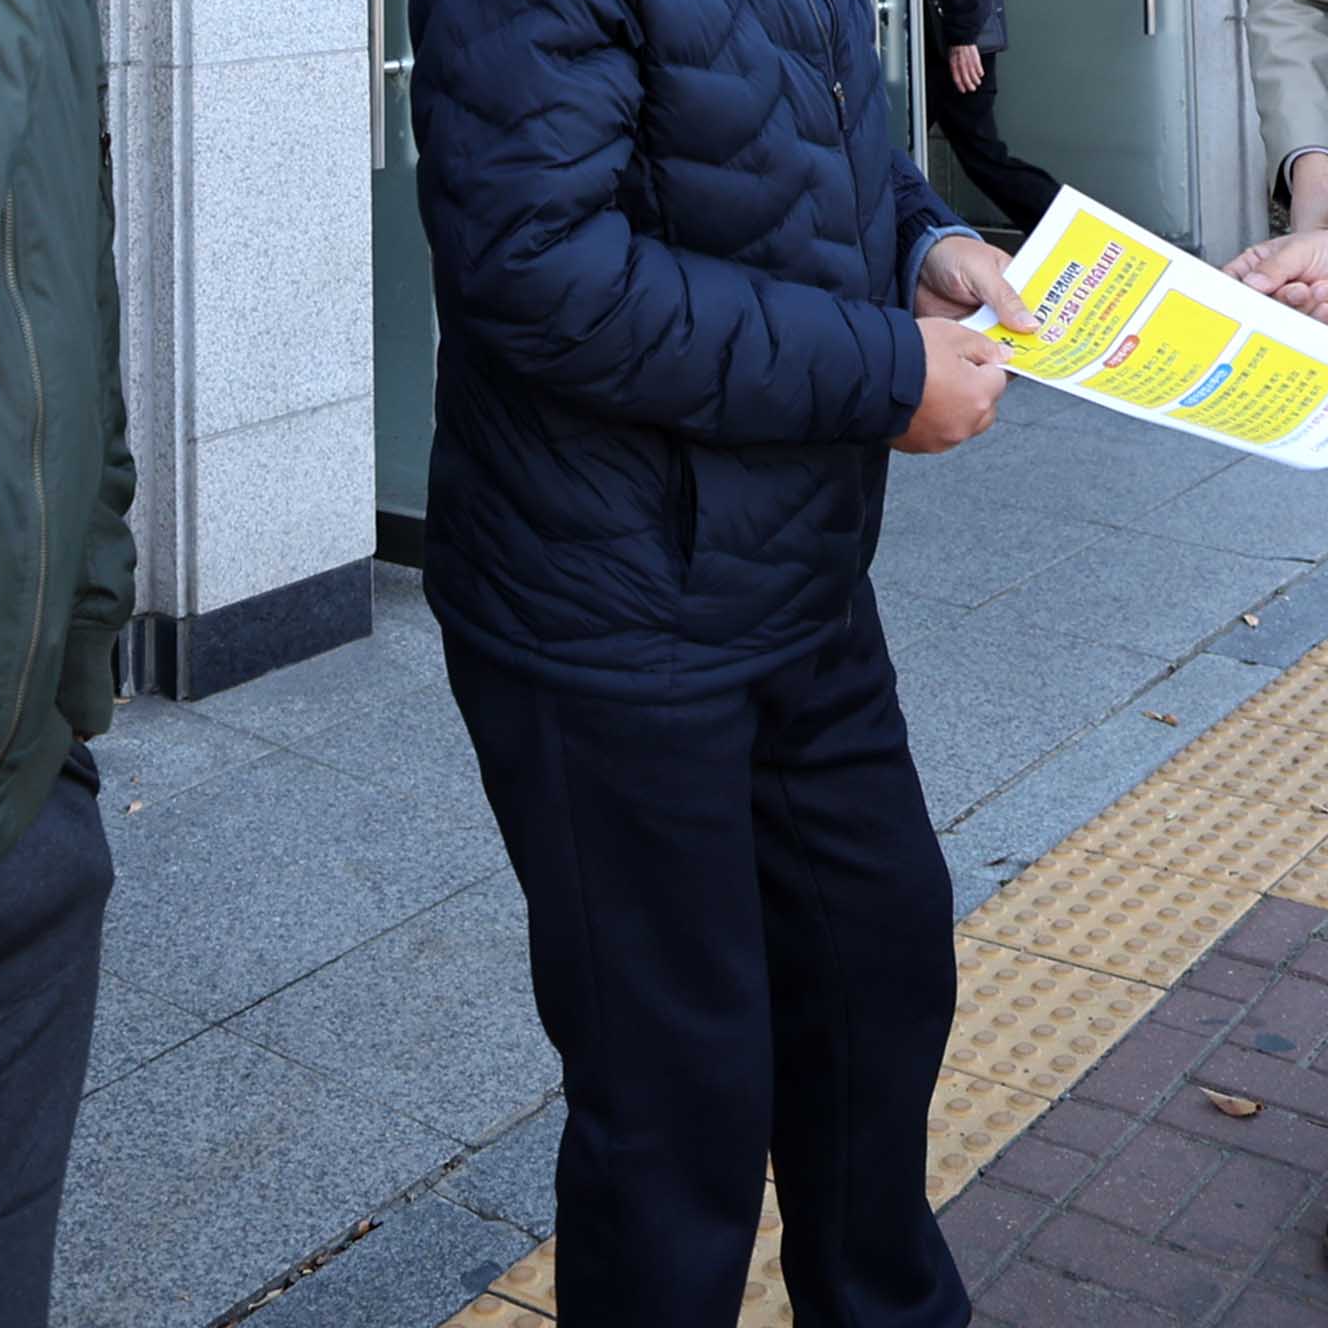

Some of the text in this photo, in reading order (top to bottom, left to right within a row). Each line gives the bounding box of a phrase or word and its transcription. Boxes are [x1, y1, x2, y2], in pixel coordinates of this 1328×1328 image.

[1045, 260, 1083, 306] 발생하면
[1056, 297, 1082, 326] 것을
[1072, 284, 1091, 302] 다
